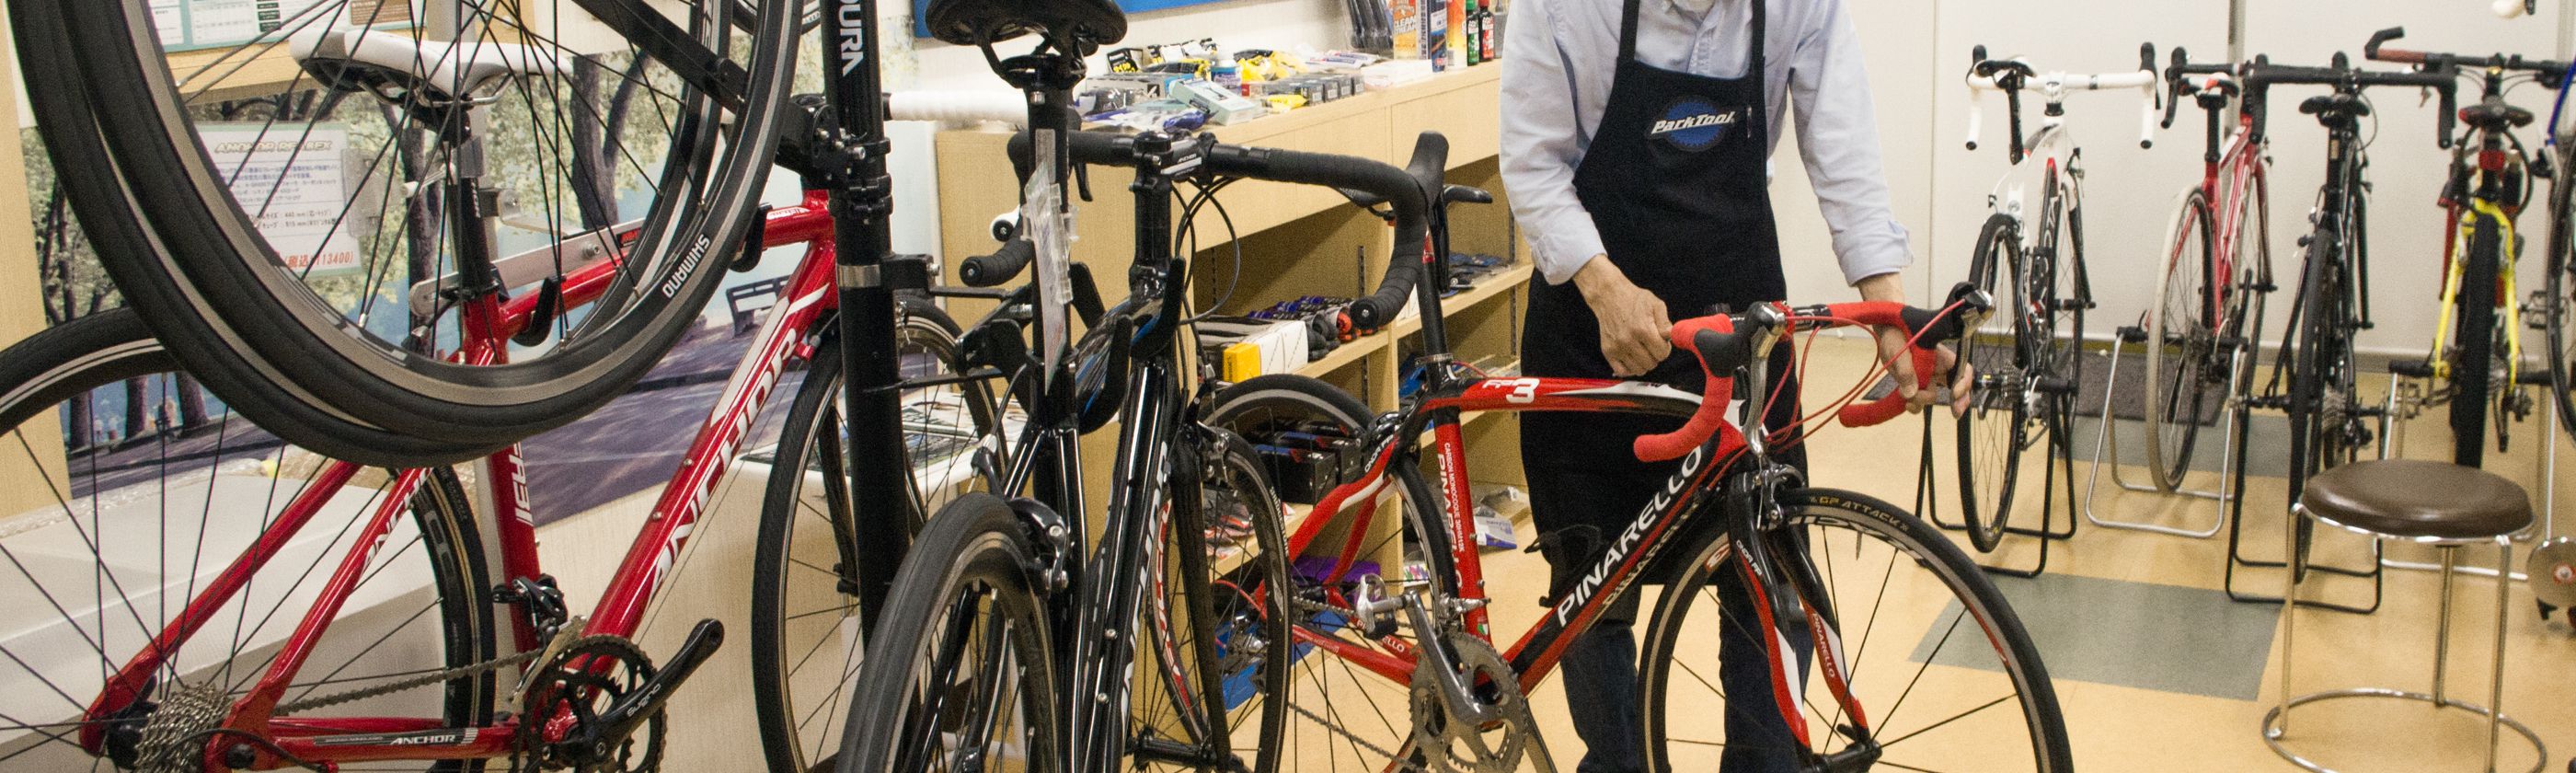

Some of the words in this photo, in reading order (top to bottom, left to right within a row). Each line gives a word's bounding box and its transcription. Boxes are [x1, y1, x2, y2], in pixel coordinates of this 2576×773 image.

[838, 0, 864, 77] URA
[662, 234, 710, 298] SHIMANO
[1558, 445, 1702, 628] PINARELLO
[1842, 500, 1901, 526] ATTACK
[1811, 614, 1835, 678] PINARELLO
[390, 734, 456, 745] ANCHOR
